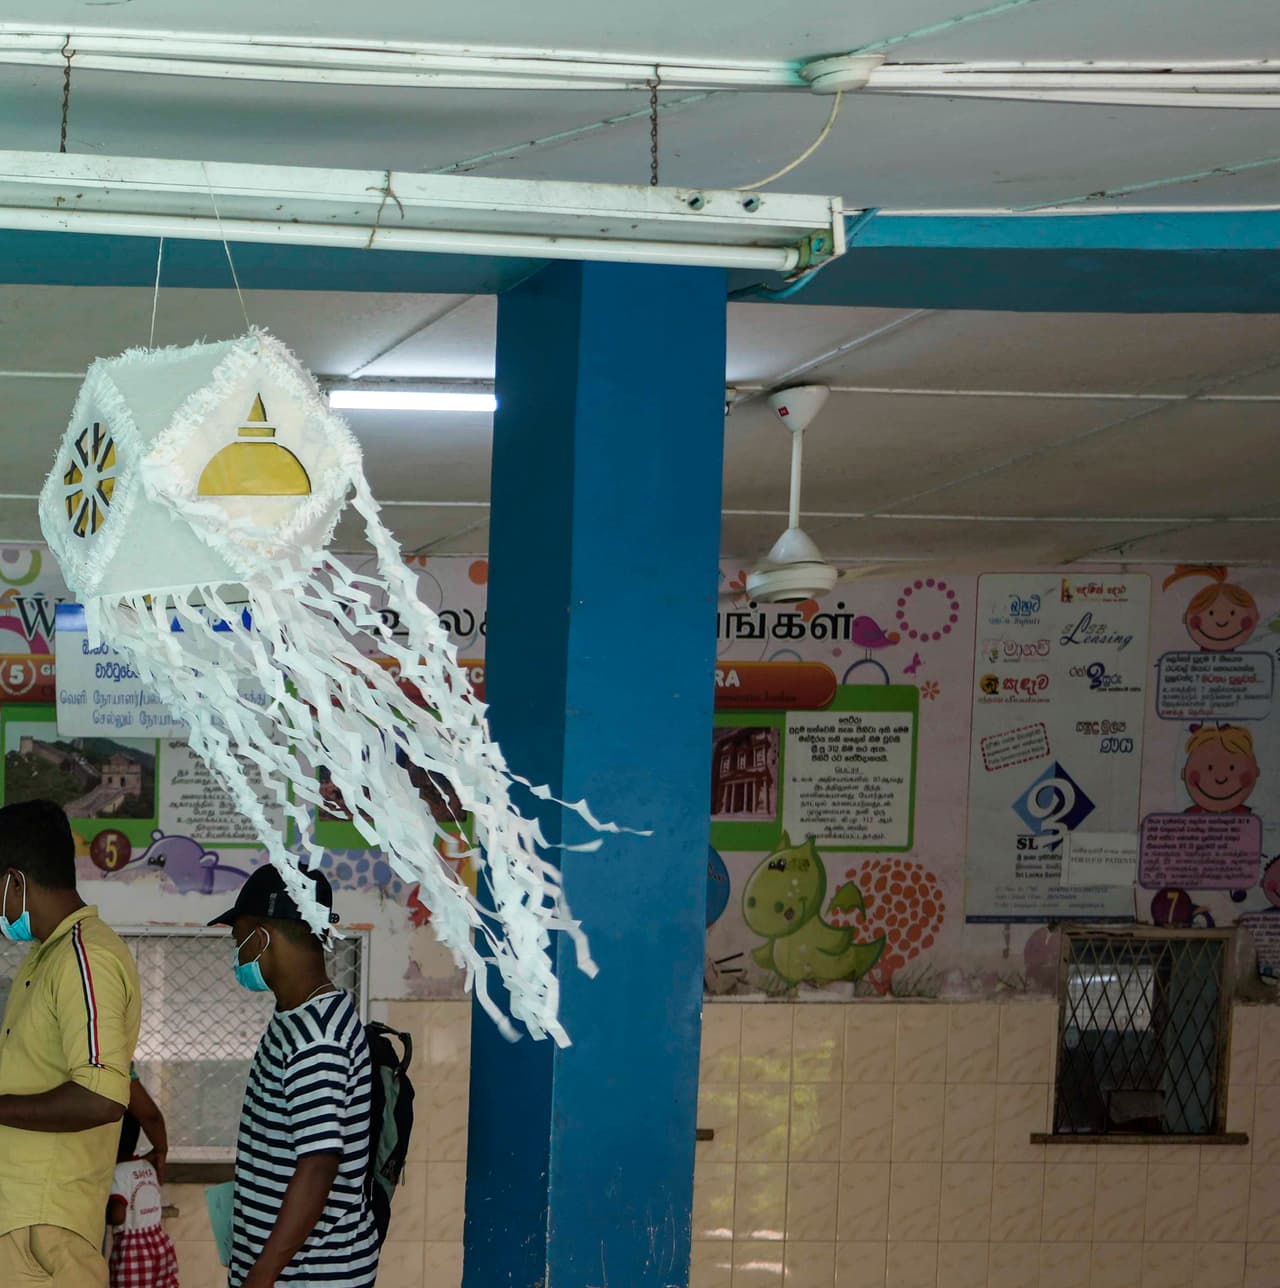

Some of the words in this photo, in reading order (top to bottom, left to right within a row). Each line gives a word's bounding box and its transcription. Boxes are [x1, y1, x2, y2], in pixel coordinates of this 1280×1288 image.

[9, 662, 24, 683] 5
[104, 835, 119, 868] 5
[1167, 891, 1180, 924] 7
